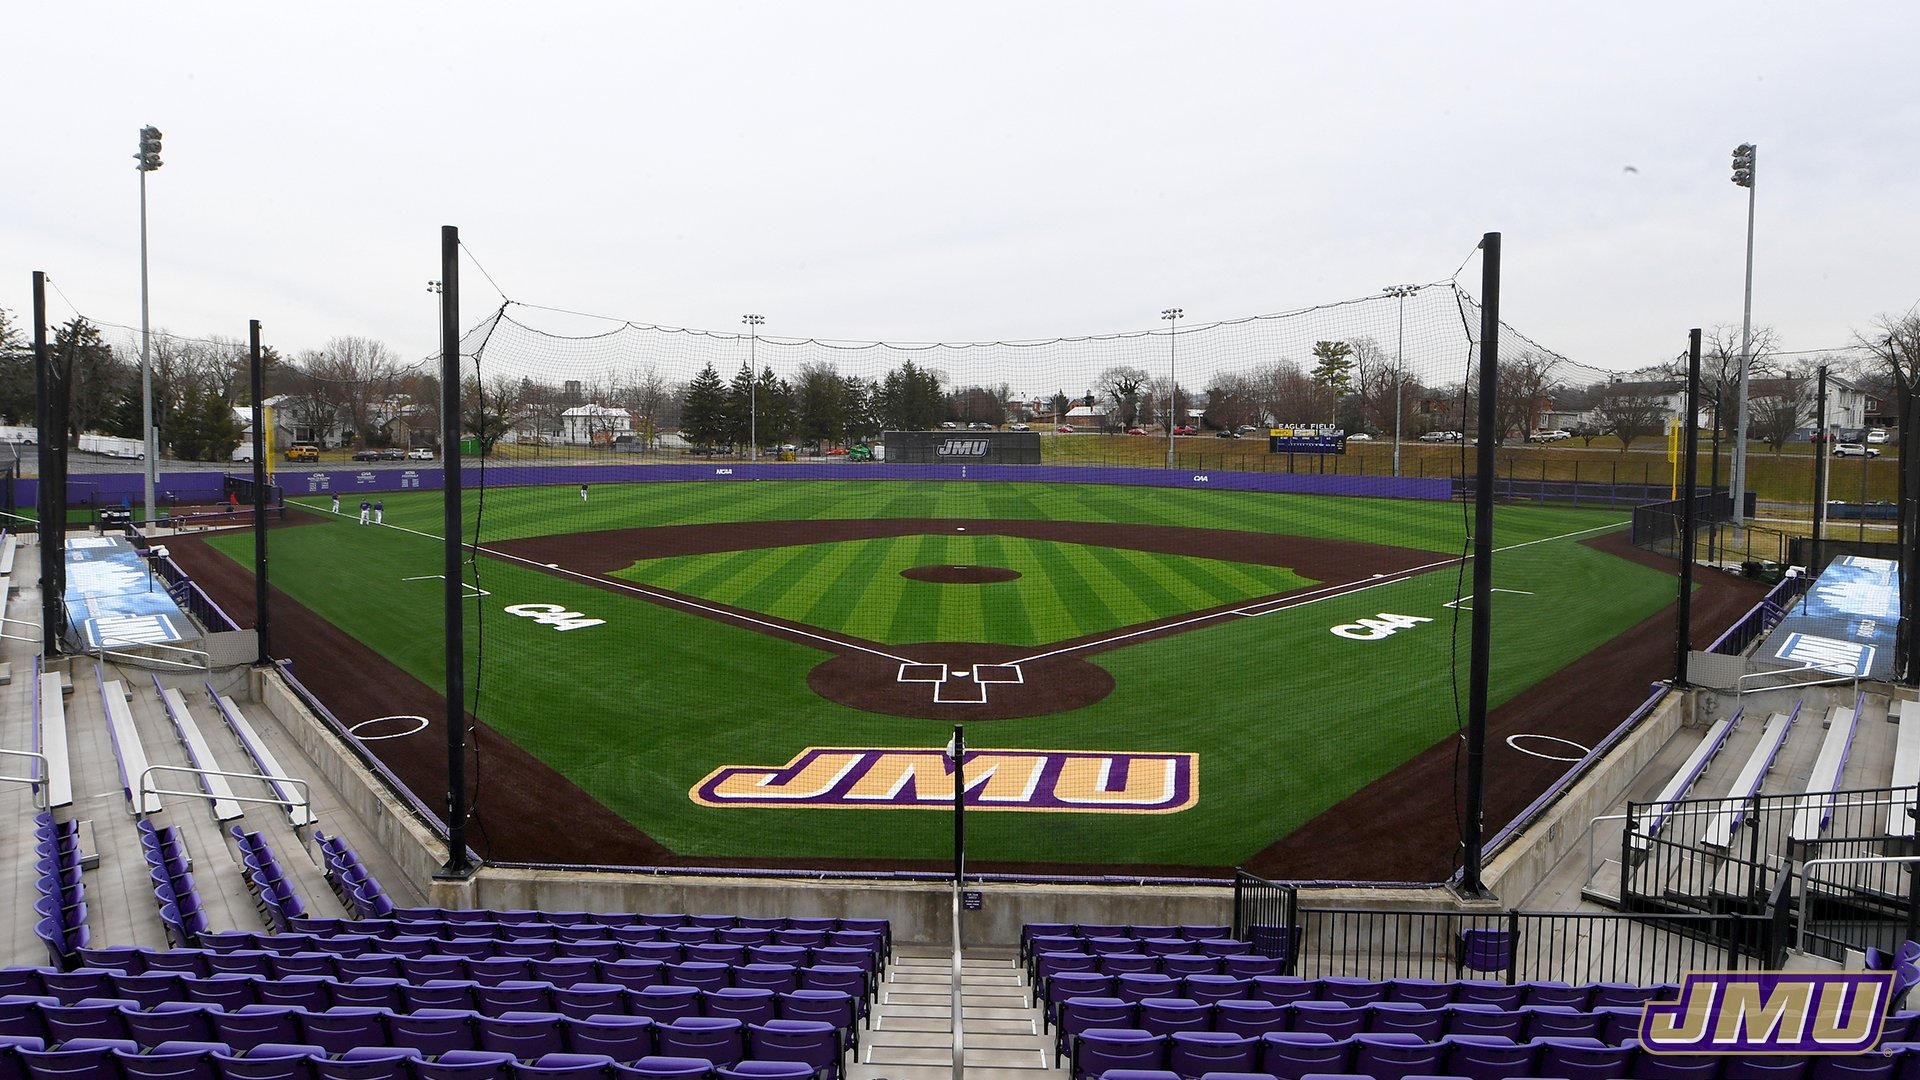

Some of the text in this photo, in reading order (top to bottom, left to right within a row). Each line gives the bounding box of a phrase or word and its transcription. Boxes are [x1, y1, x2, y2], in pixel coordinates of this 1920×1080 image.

[938, 440, 988, 455] JMU
[504, 604, 607, 632] CAA
[1330, 613, 1434, 640] CAA
[704, 750, 1184, 808] JMU
